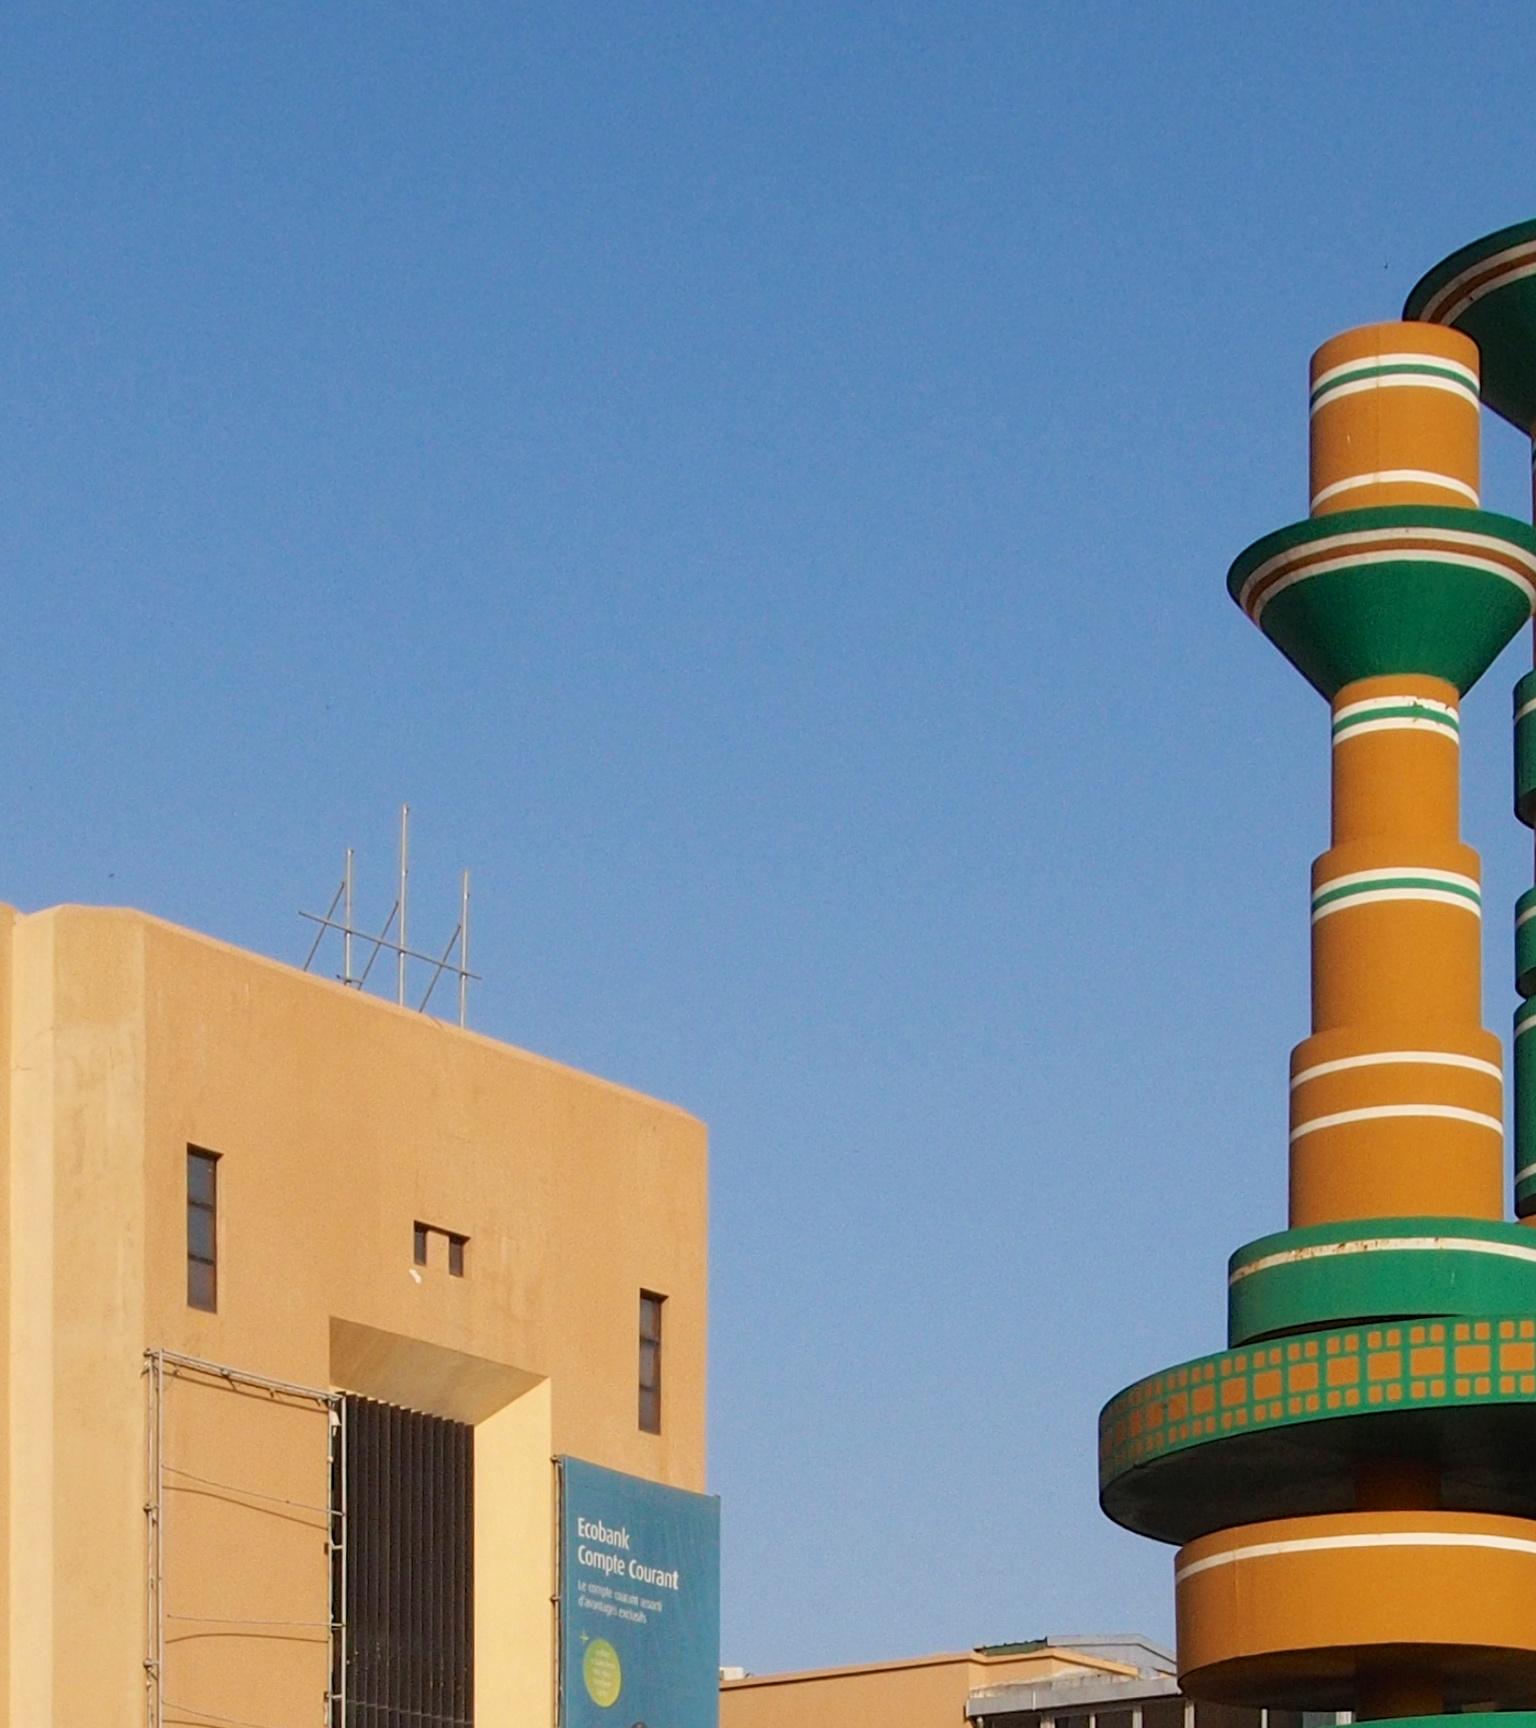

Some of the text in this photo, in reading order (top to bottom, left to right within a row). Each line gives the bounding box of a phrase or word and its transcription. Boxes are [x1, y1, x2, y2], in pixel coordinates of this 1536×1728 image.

[577, 1517, 630, 1550] Ecobank
[577, 1545, 679, 1590] Compte Courant
